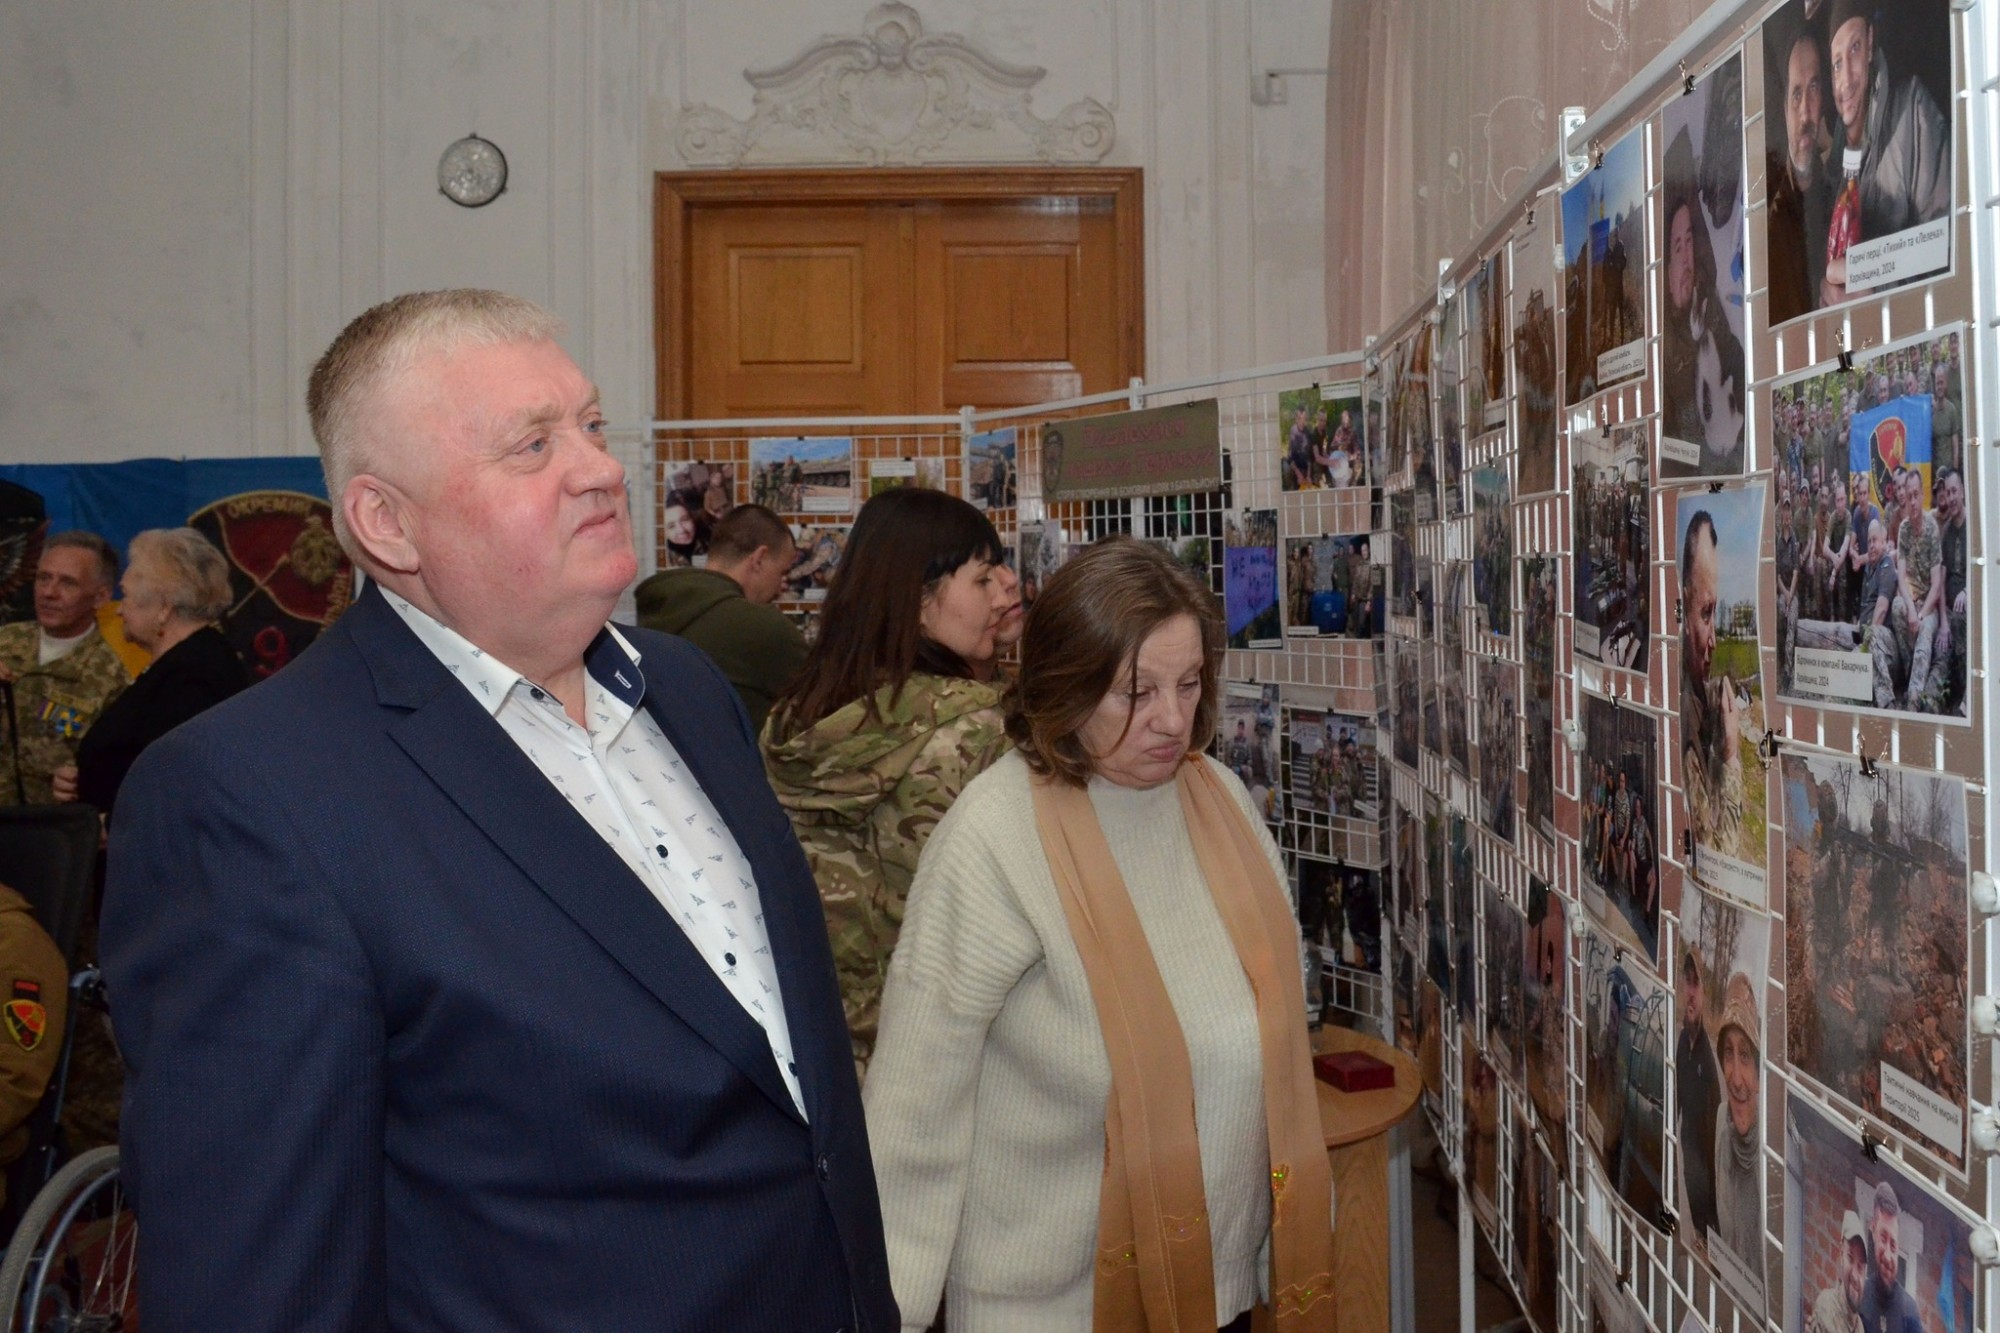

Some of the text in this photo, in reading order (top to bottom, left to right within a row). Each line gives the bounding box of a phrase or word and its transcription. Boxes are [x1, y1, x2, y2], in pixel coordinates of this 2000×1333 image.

[1882, 261, 1895, 275] 2024
[227, 496, 312, 519] ОКРЕМИЙ
[1907, 1105, 1920, 1122] 2025
